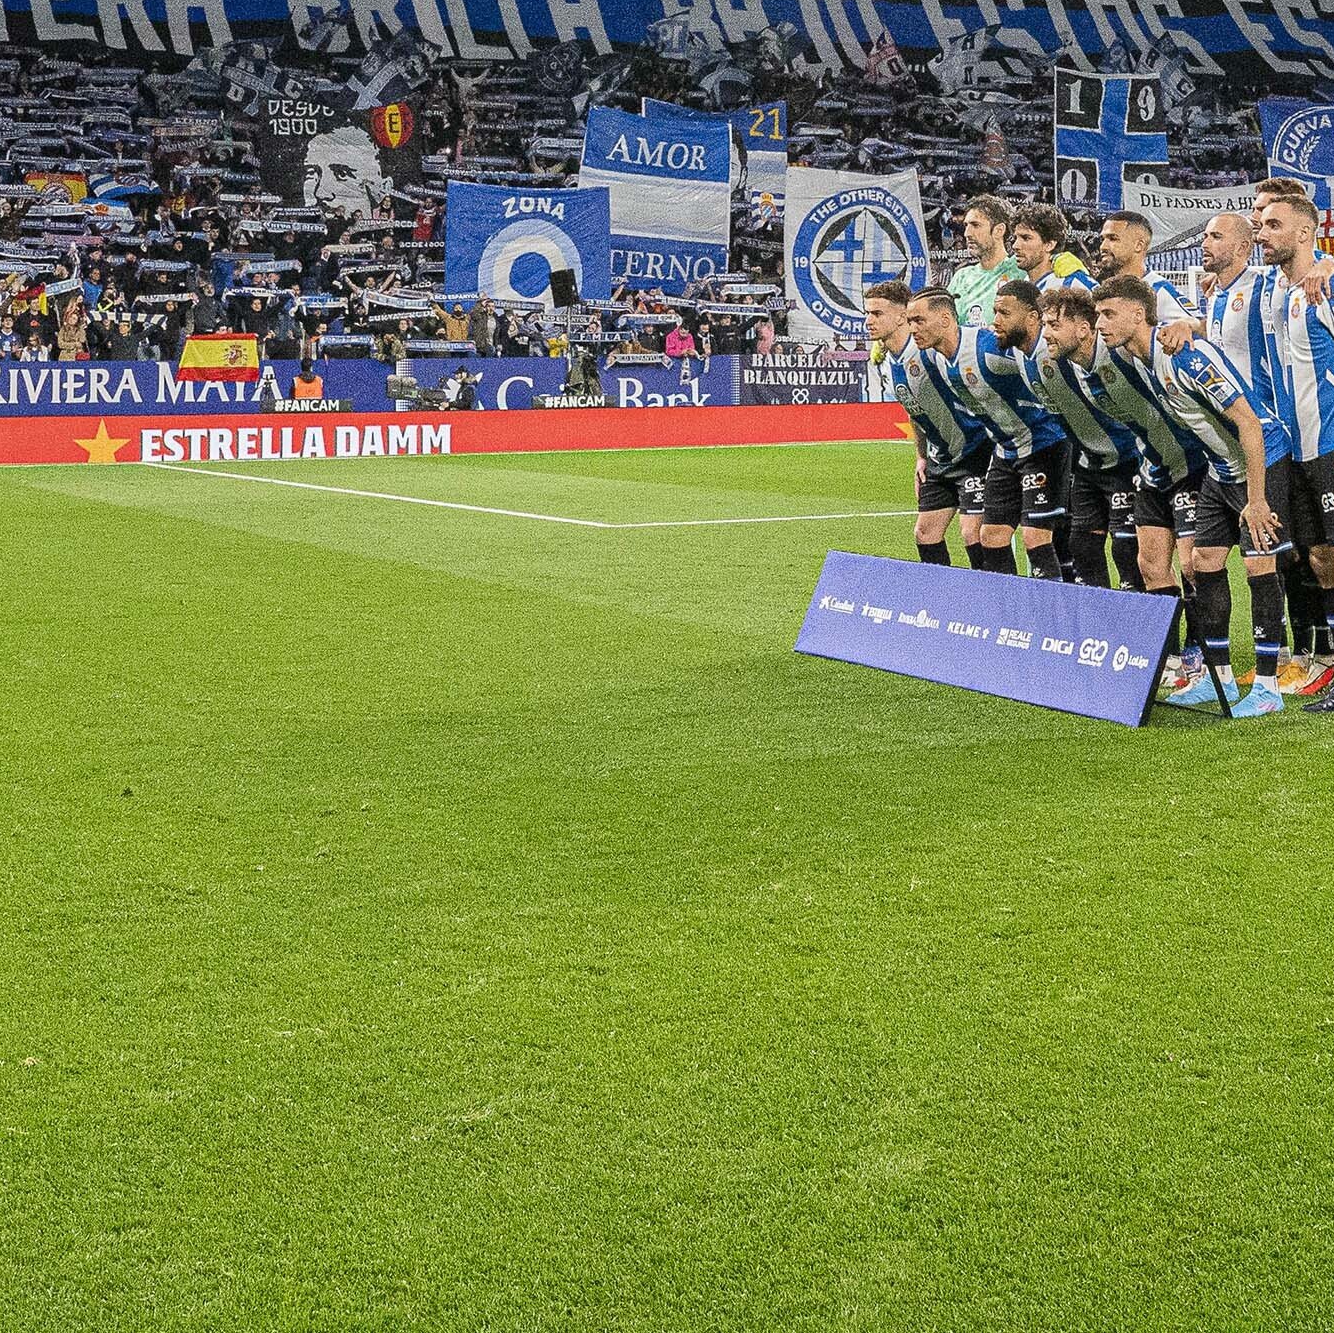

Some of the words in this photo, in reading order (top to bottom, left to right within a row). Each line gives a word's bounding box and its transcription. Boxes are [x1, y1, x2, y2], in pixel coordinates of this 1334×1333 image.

[269, 118, 318, 136] 1900
[748, 108, 784, 141] 21
[1283, 113, 1332, 164] CURVA
[605, 133, 708, 172] AMOR
[501, 196, 566, 222] ZONA
[1140, 191, 1163, 208] DE
[1167, 192, 1222, 210] PADRES
[1224, 195, 1238, 211] A
[809, 198, 839, 225] THE
[793, 256, 809, 268] 19
[811, 300, 833, 321] OF
[743, 369, 859, 386] BLANQUIAZUL
[273, 398, 341, 413] #FANCAM
[545, 395, 606, 409] #FANCAM
[140, 426, 326, 462] ESTRELLA
[334, 423, 452, 458] DAMM
[964, 477, 984, 491] GR
[946, 620, 982, 640] KELME
[1040, 636, 1075, 656] DIGI
